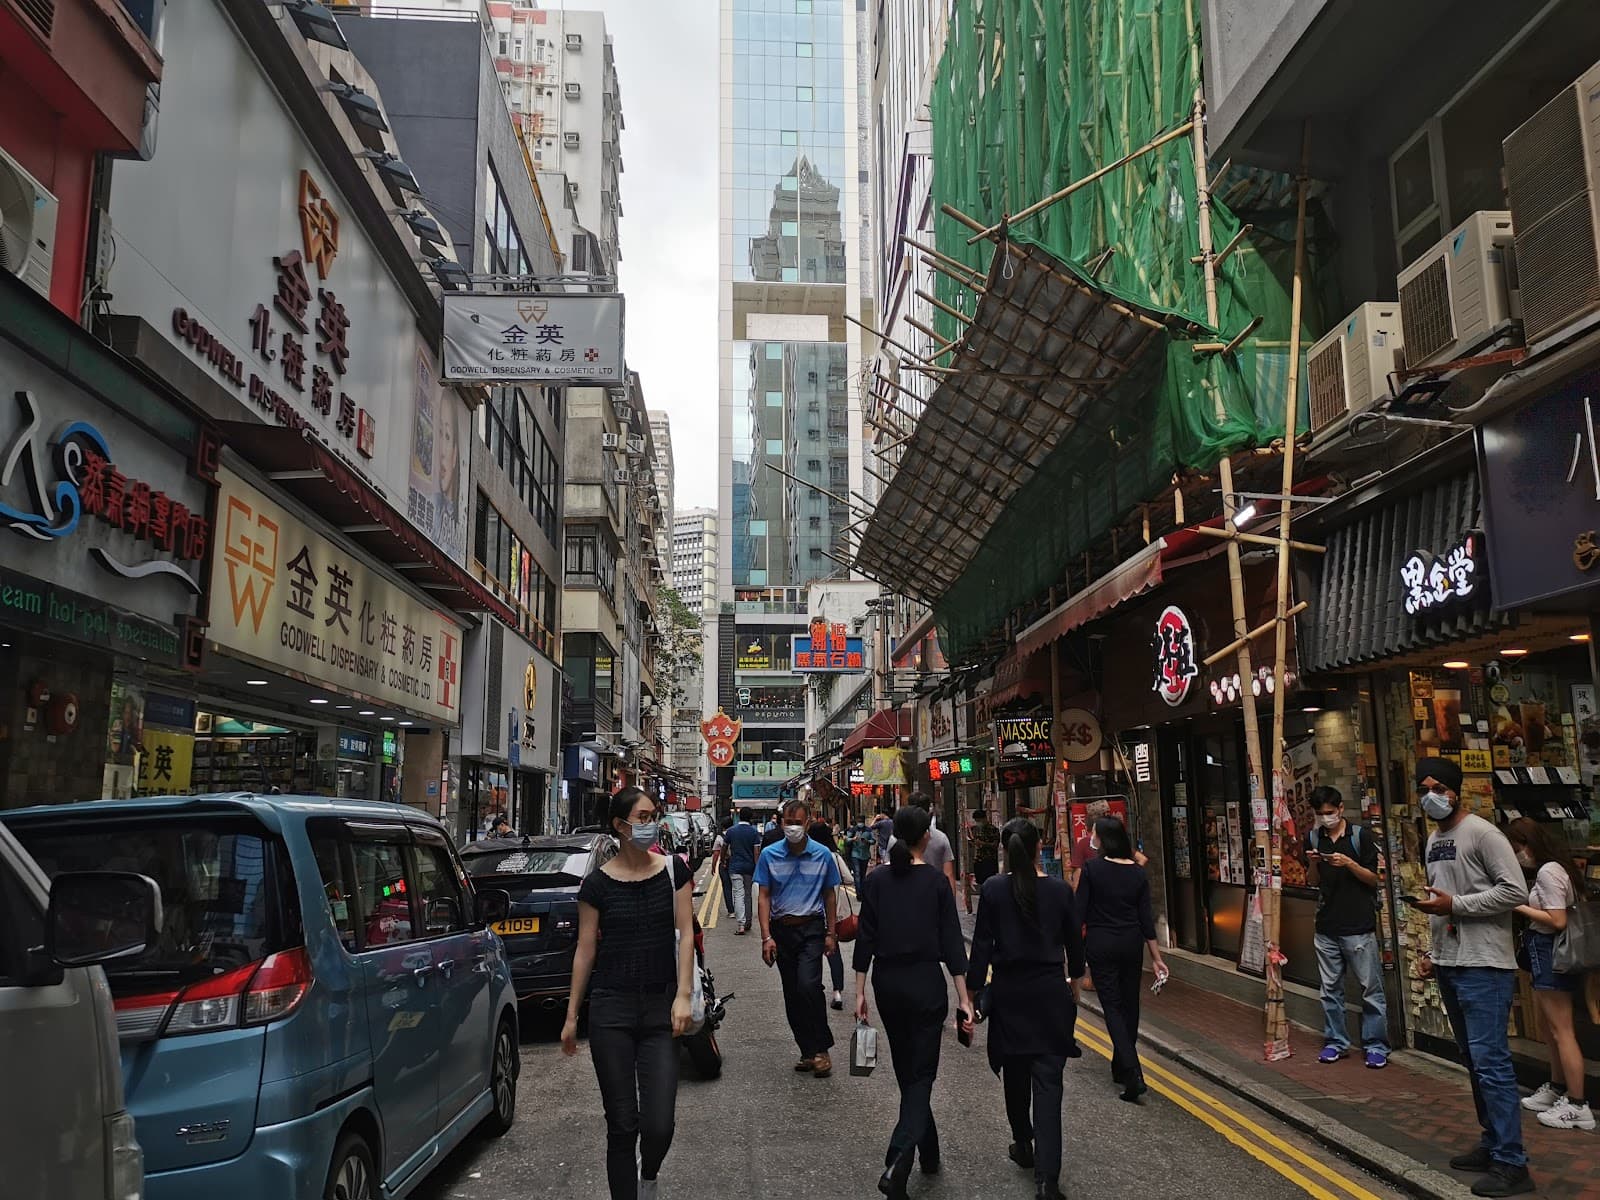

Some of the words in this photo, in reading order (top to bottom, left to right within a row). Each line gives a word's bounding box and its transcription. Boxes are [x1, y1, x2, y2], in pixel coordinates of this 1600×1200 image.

[500, 323, 565, 345] 金英
[173, 307, 246, 389] GODWELL
[450, 366, 489, 375] GODWELL
[492, 366, 541, 375] DISPENSARY
[554, 366, 595, 375] COSMETIC
[598, 366, 613, 375] LTD
[0, 584, 42, 616] eam
[280, 621, 327, 664] GODWELL
[330, 643, 380, 681] DISPENSARY
[388, 668, 419, 697] COSMETIC
[420, 682, 431, 701] LTD
[1000, 721, 1049, 741] MASSAG
[497, 919, 533, 932] 4109
